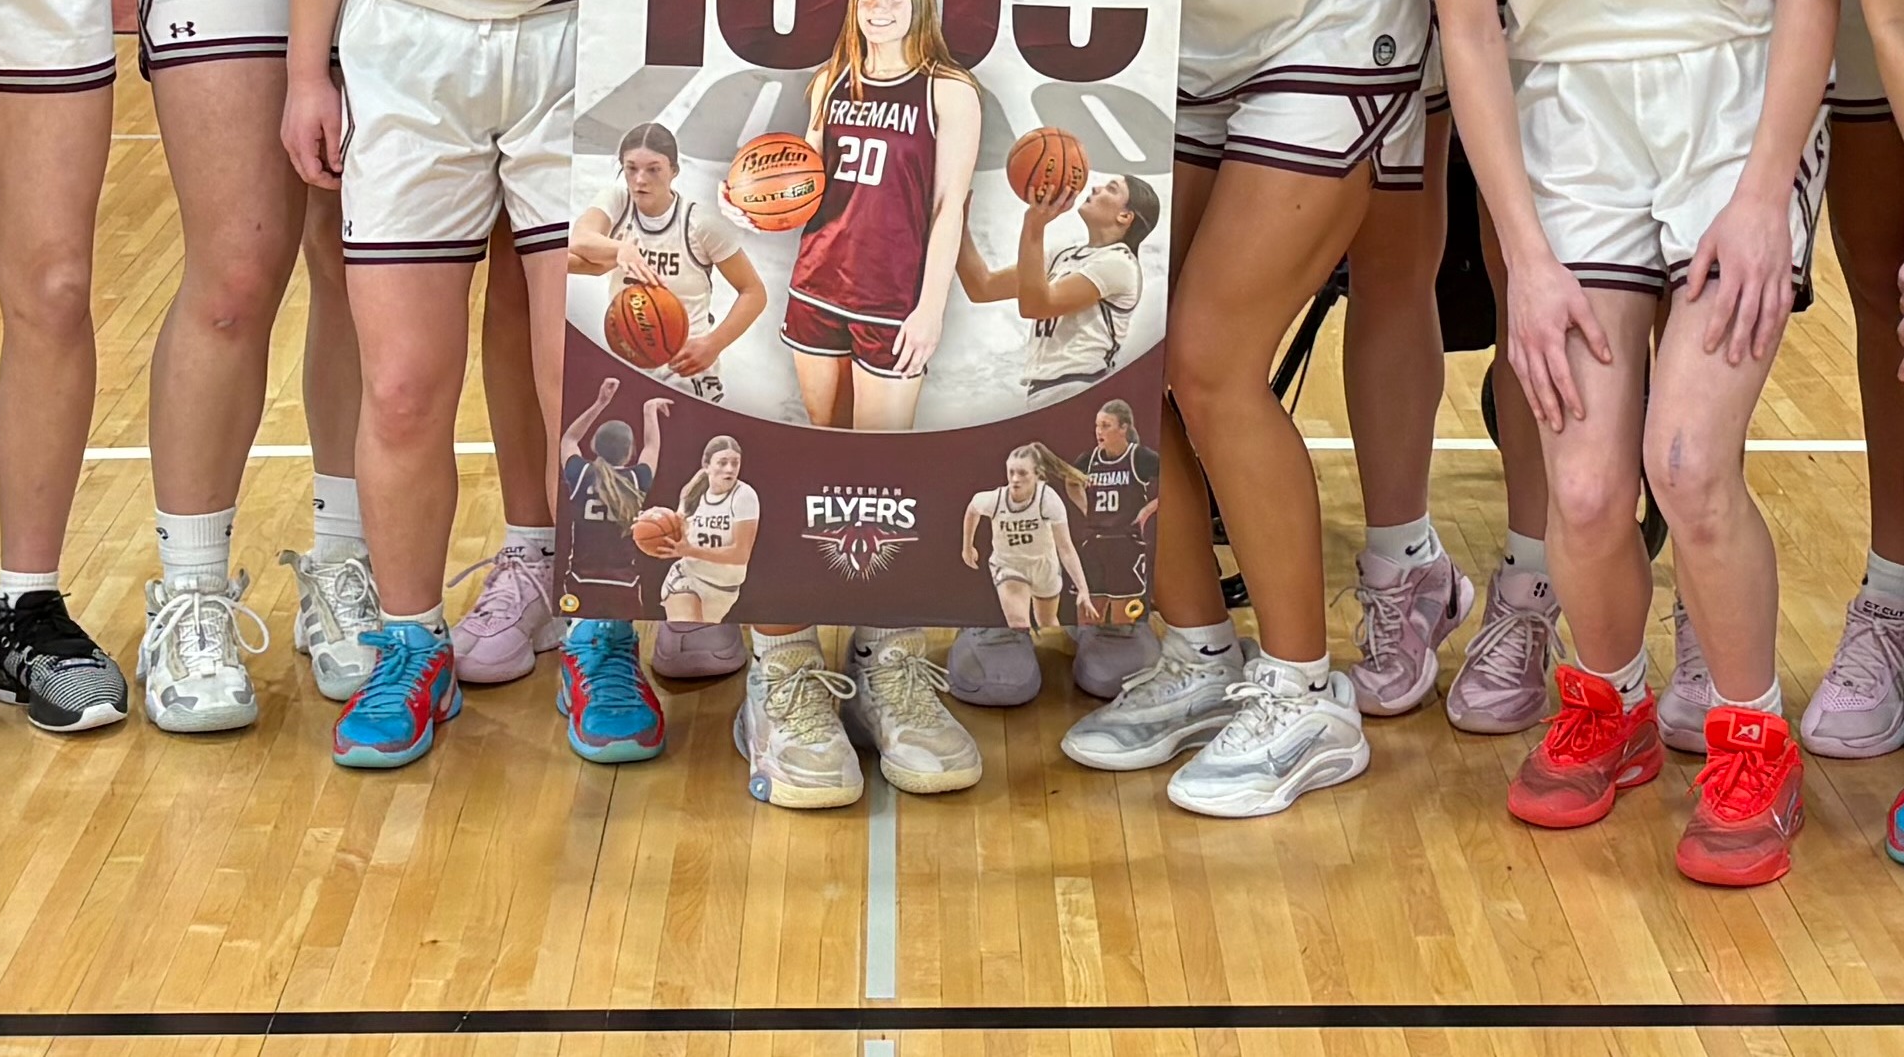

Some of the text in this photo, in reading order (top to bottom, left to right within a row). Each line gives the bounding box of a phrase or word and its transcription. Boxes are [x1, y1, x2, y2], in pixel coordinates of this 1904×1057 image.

[827, 99, 919, 136] FREEMAN
[833, 135, 888, 187] 20
[822, 485, 903, 497] FREEMAN
[1095, 490, 1120, 513] 20
[805, 495, 917, 530] FLYERS
[999, 518, 1040, 533] FLYERS
[1007, 533, 1034, 548] 20
